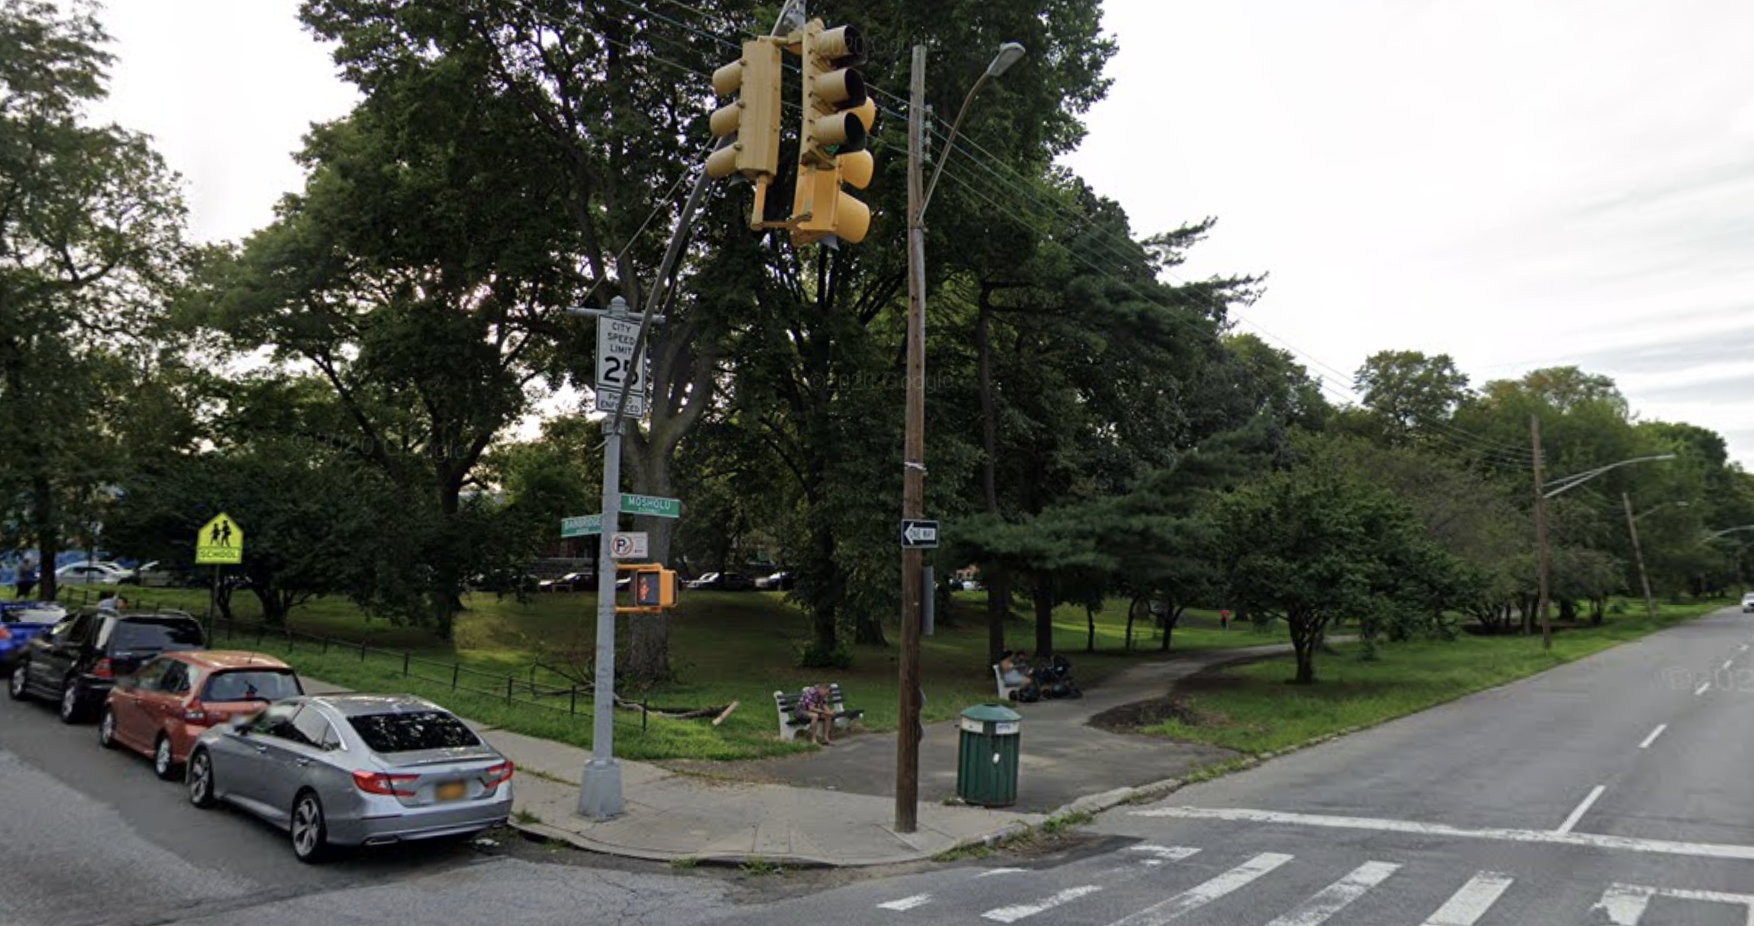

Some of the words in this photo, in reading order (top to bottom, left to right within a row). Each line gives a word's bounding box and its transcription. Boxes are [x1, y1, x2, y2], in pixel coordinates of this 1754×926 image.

[611, 322, 632, 333] CITY
[607, 333, 635, 346] SPEED
[610, 345, 632, 355] LIMIT
[628, 496, 671, 510] MOSHOLU
[199, 549, 238, 558] SCHOOL
